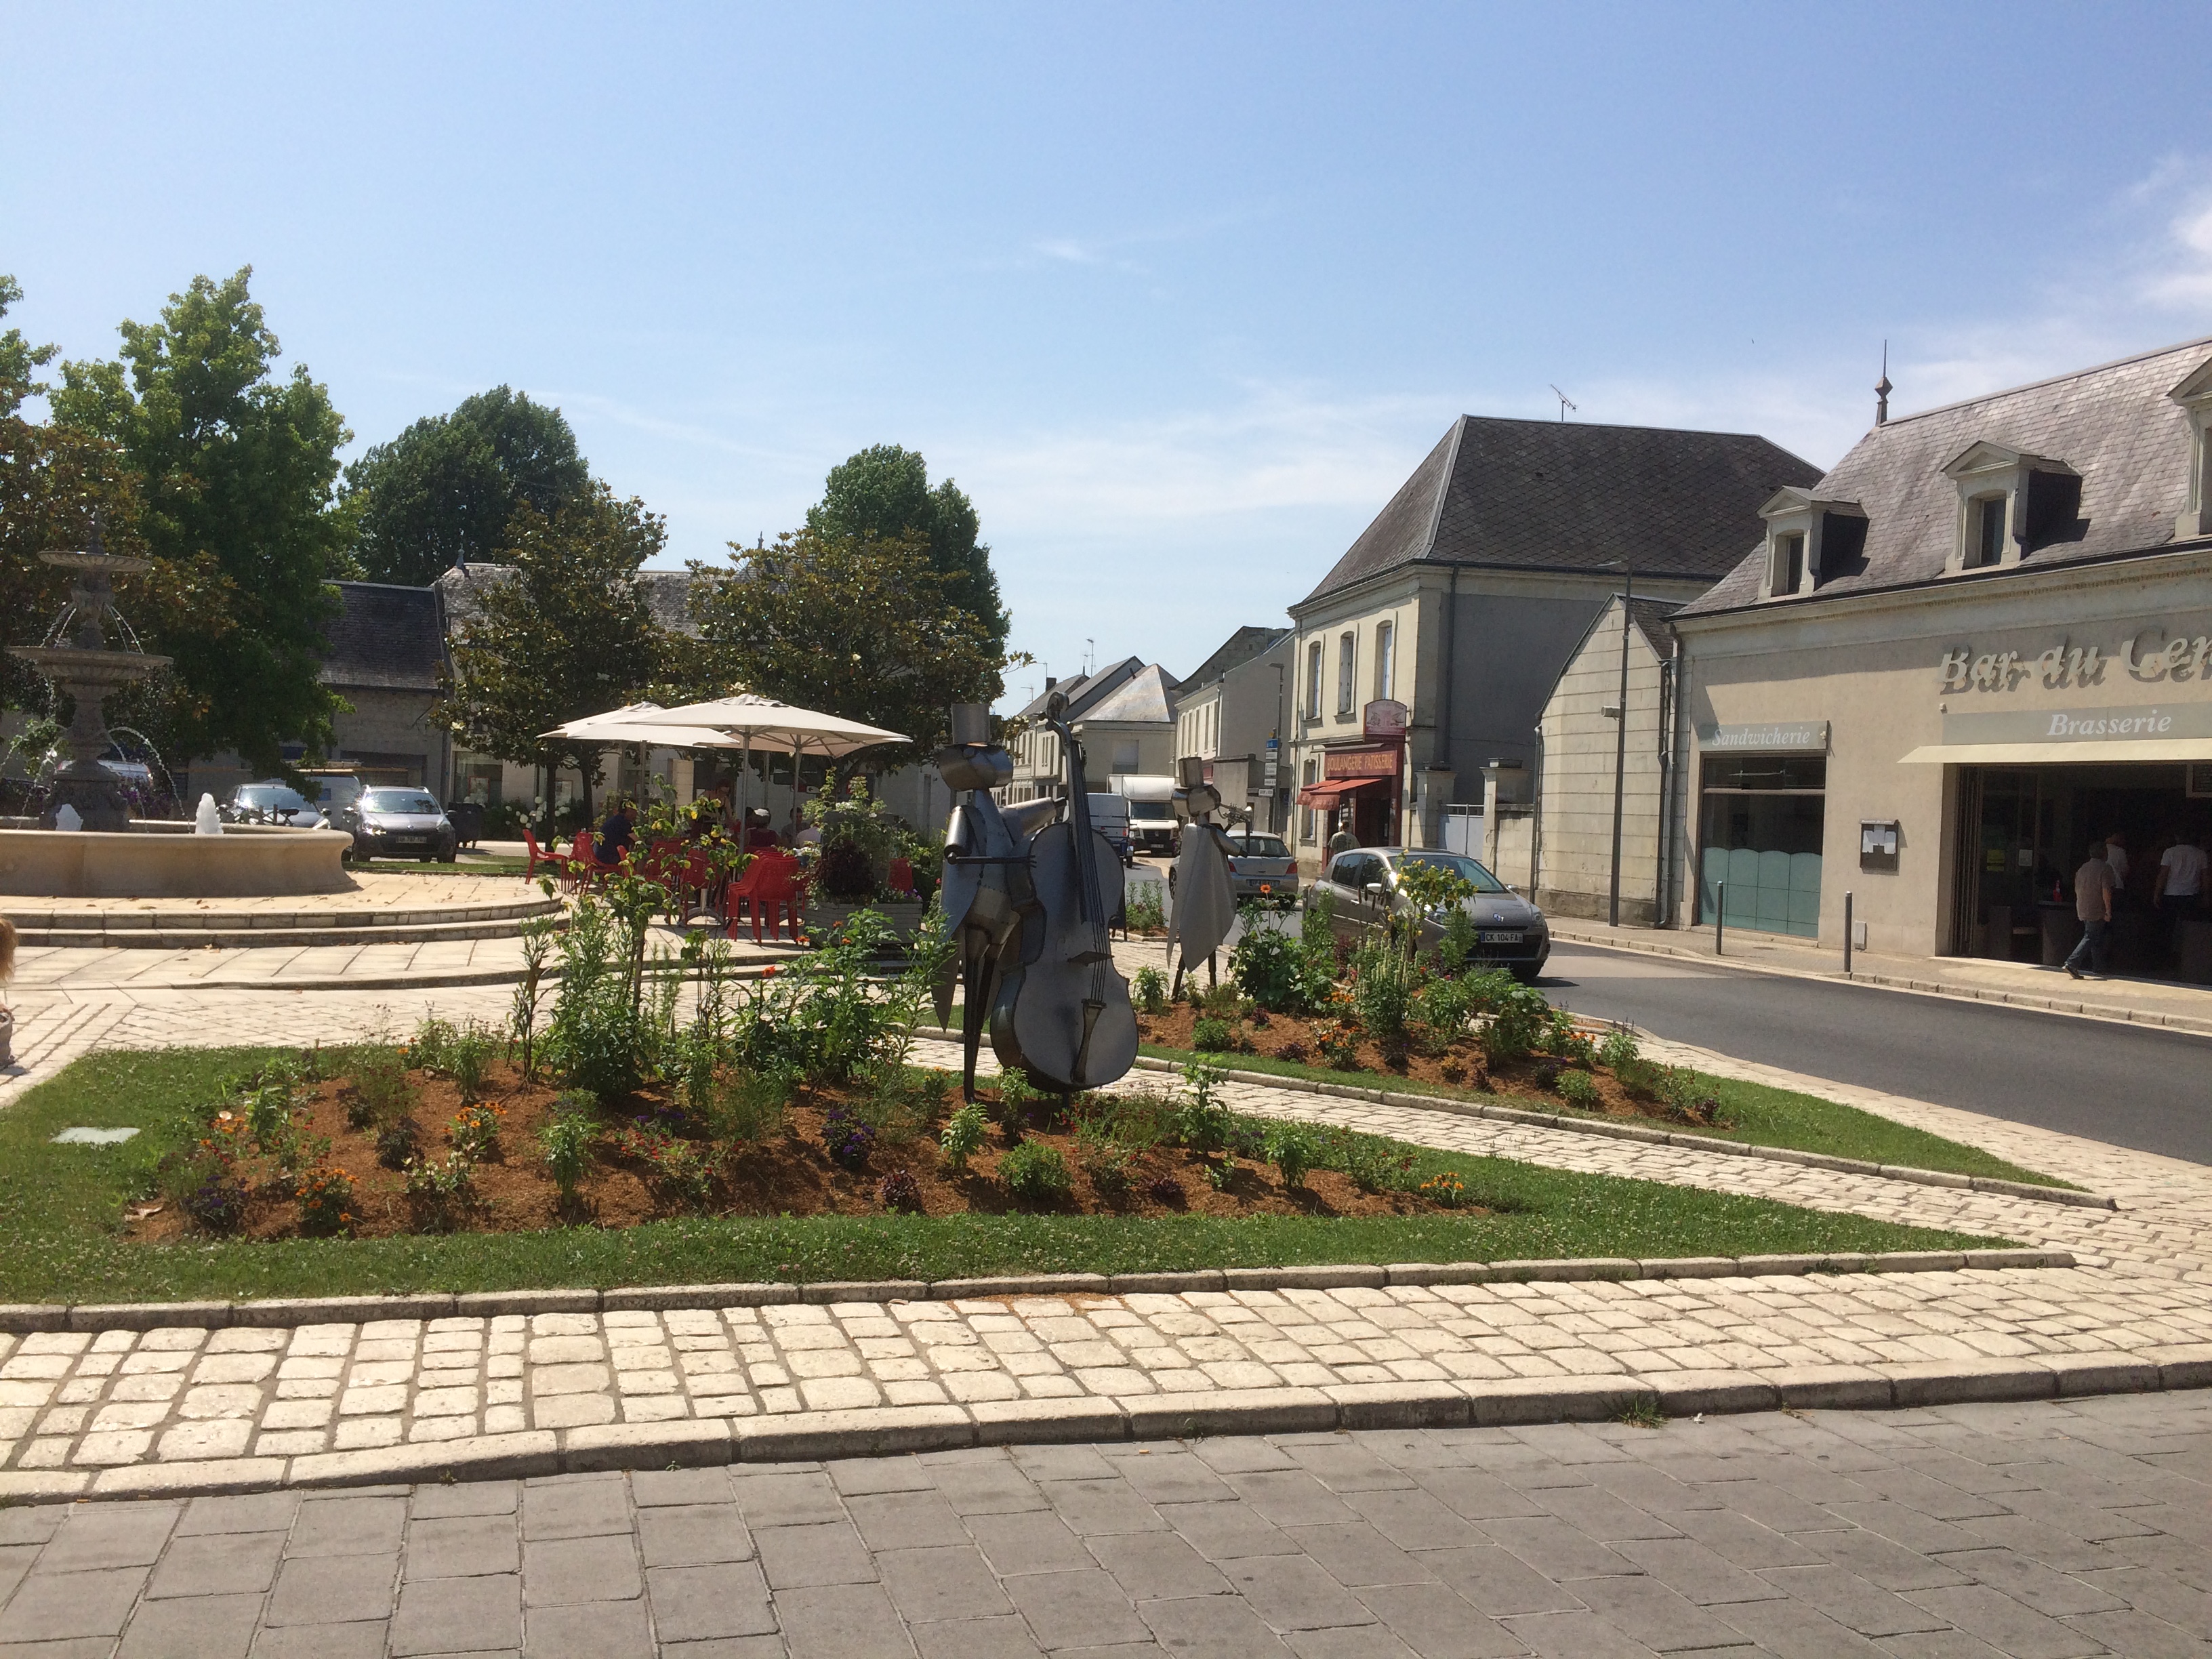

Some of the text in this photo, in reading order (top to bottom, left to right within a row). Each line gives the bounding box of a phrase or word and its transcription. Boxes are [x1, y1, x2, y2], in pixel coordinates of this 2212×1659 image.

[1936, 644, 2018, 686] Bar
[2035, 633, 2102, 680] du
[2047, 709, 2171, 736] Brasserie
[1712, 726, 1811, 746] Sandwicherie
[1327, 756, 1362, 771] BOULANGERIE
